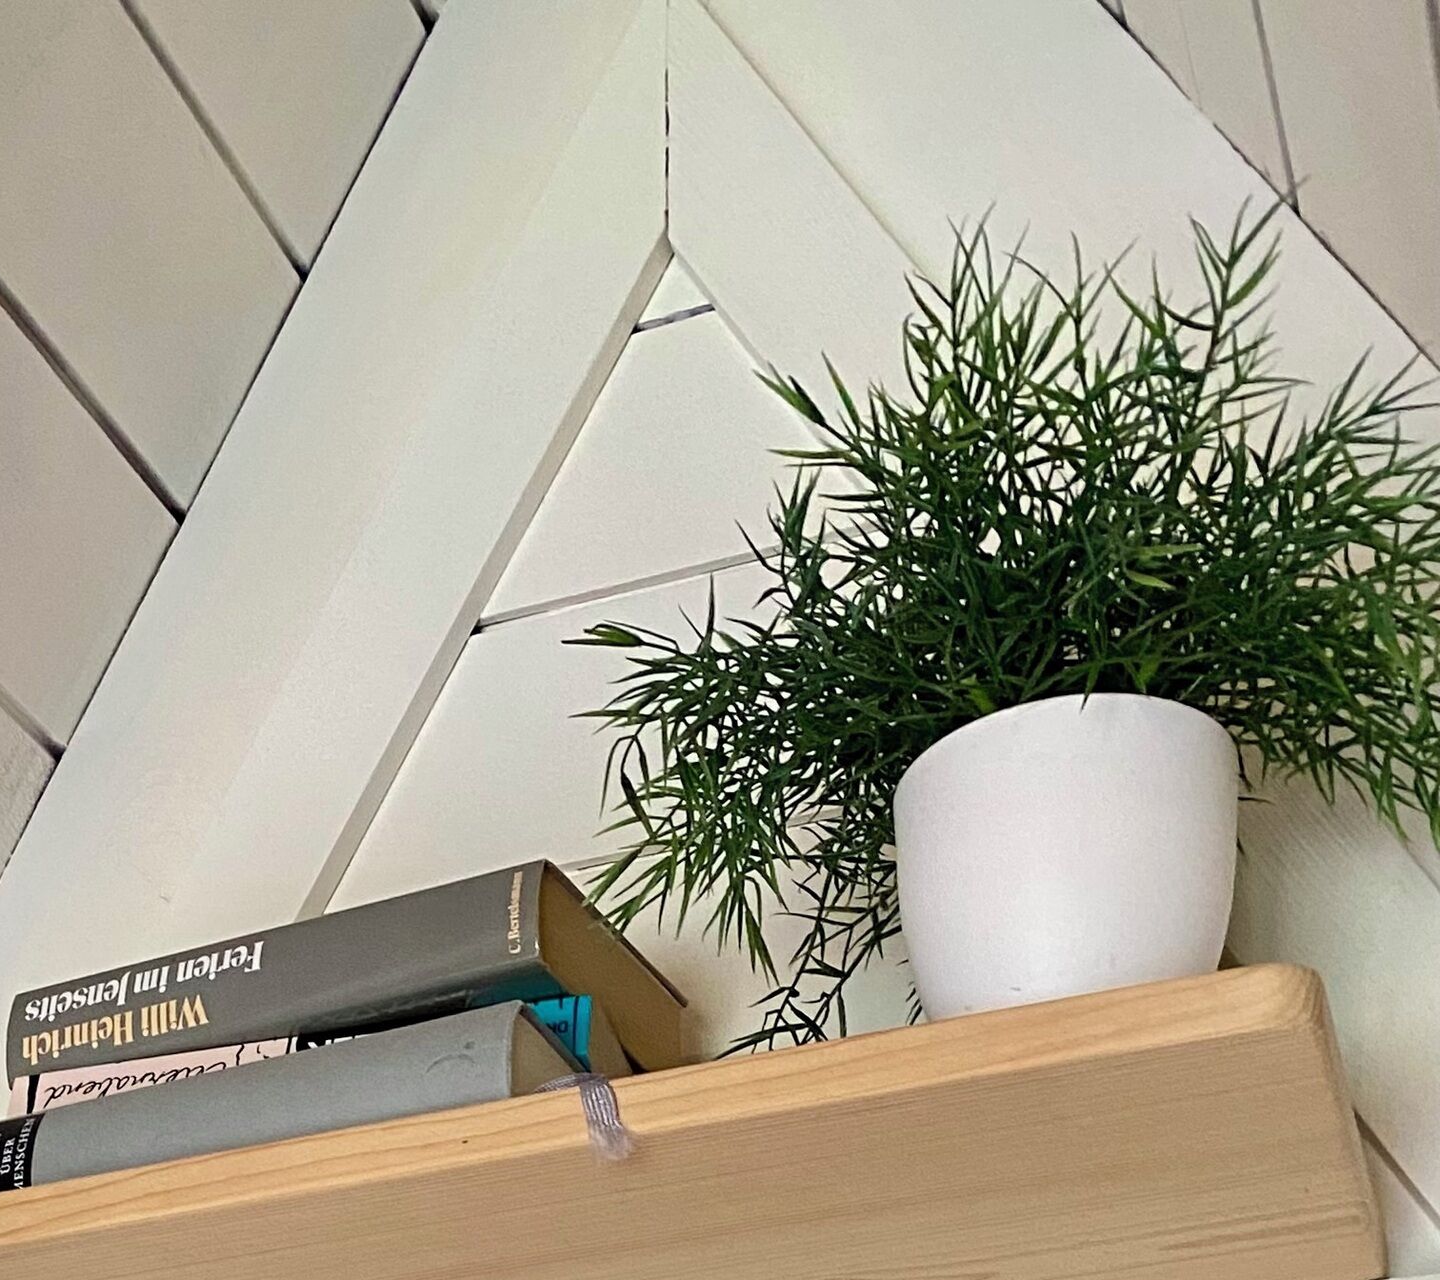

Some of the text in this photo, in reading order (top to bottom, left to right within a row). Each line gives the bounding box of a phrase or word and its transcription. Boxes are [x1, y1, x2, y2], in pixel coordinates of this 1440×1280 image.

[24, 940, 265, 1024] Ferien im Jenseits
[21, 993, 210, 1066] Willi Heinrich
[0, 1137, 17, 1176] ÜBER
